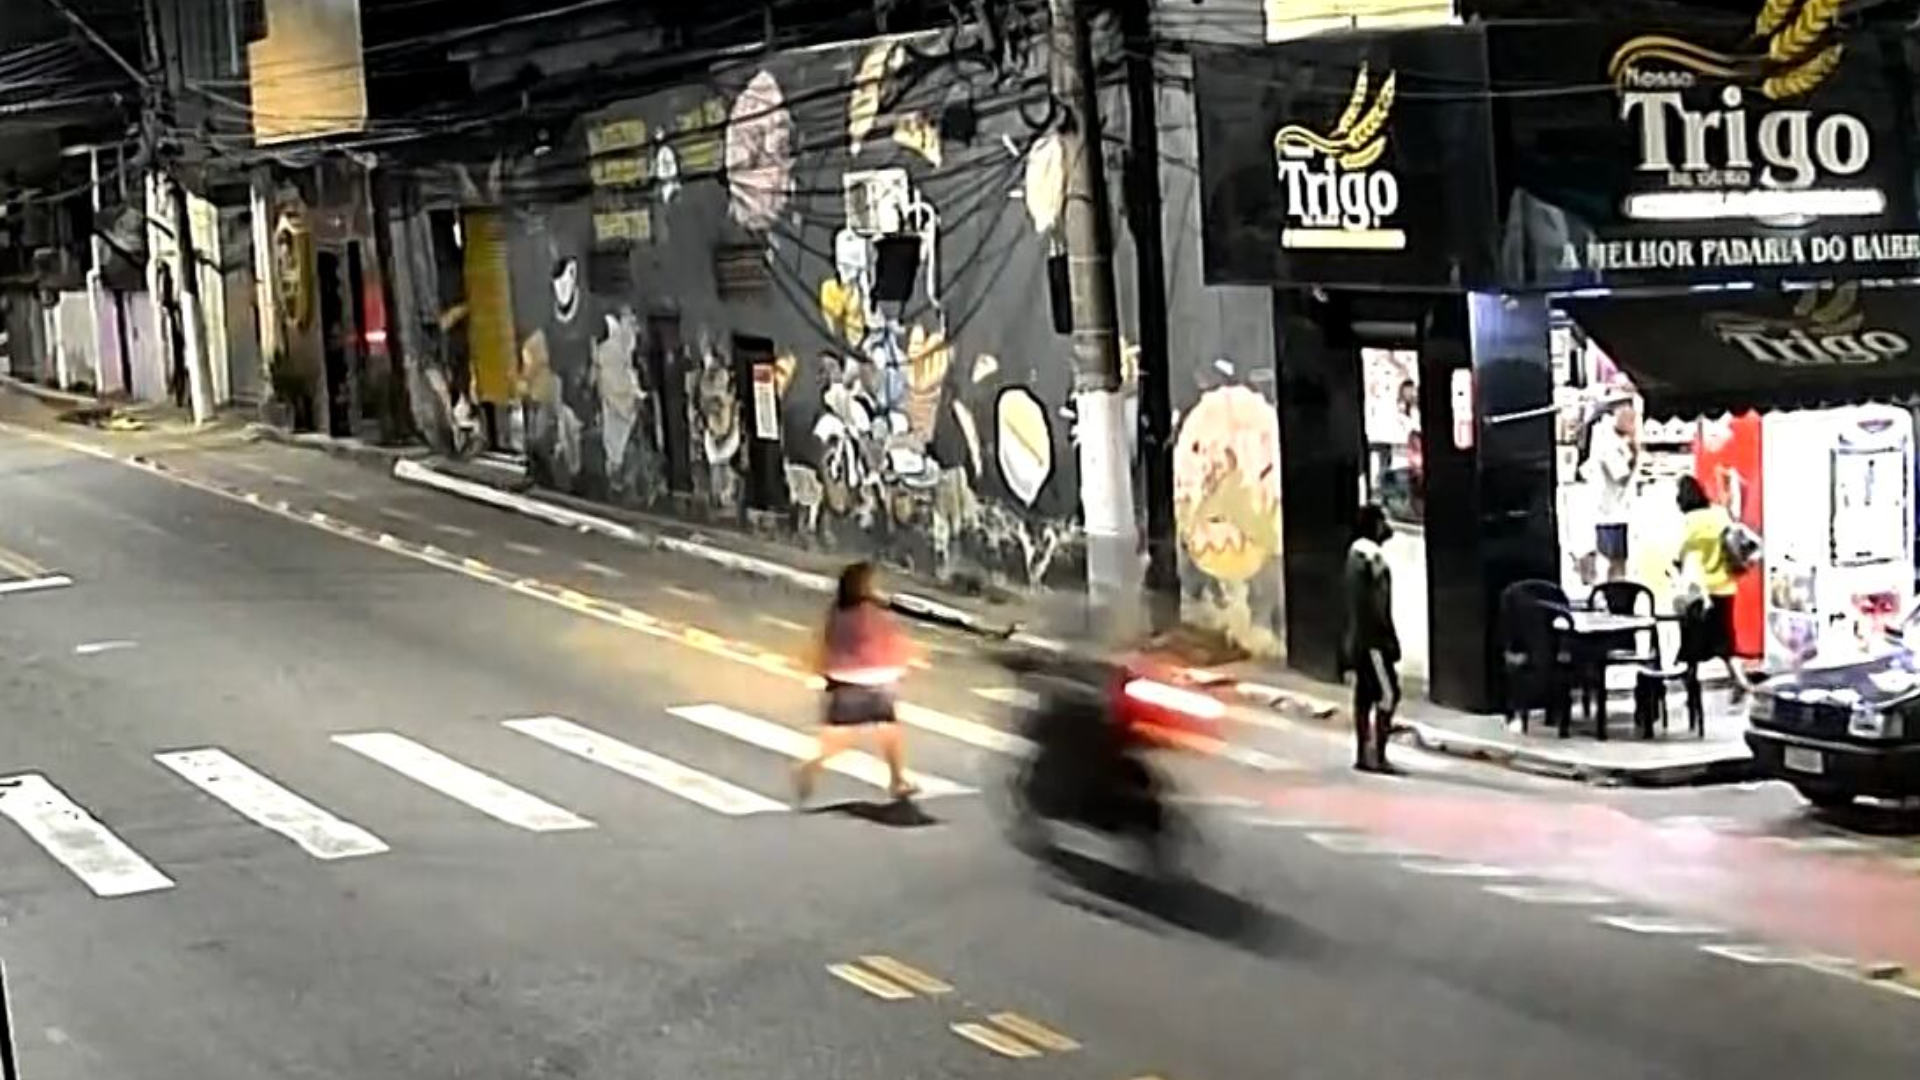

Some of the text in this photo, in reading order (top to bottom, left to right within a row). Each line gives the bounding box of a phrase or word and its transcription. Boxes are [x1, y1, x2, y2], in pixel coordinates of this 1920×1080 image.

[1620, 85, 1870, 188] Trigo
[1278, 155, 1398, 230] Trigo
[1559, 241, 1581, 270] A
[1587, 239, 1695, 269] MELHOR
[1701, 235, 1805, 267] PADARIA
[1811, 235, 1846, 263] DO
[1720, 328, 1909, 364] Trigo
